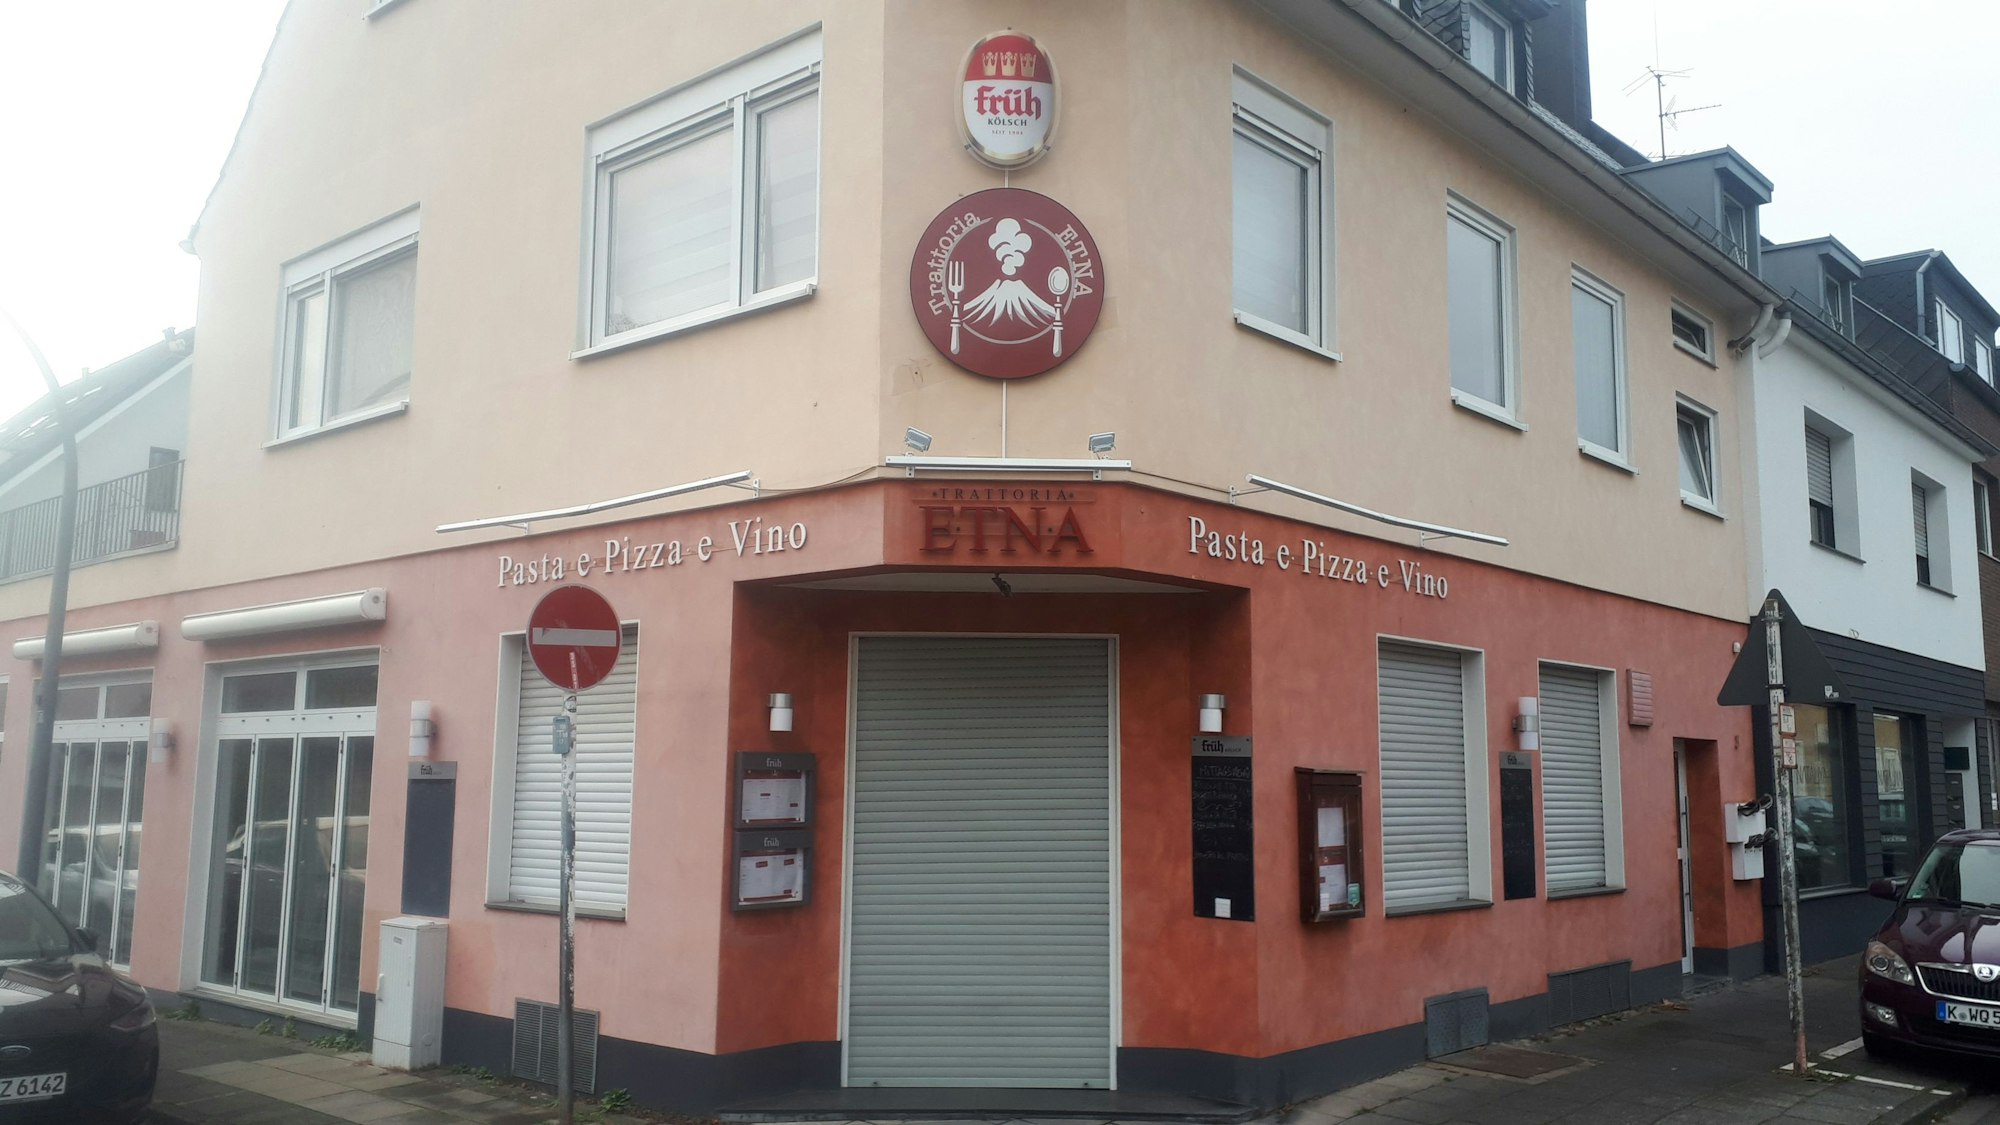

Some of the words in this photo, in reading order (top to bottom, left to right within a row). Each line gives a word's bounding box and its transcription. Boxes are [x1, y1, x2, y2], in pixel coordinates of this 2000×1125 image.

[974, 85, 1041, 120] früh
[988, 117, 1027, 126] KÖLSCH
[927, 212, 981, 316] Trattoria
[1055, 223, 1095, 299] ETNA
[939, 488, 1067, 501] TRATTORIA
[919, 506, 1094, 553] ETNA
[497, 552, 565, 587] Pasta
[577, 552, 591, 577] e
[604, 536, 683, 573] Pizza
[698, 535, 713, 562] e
[728, 516, 808, 558] Vino
[1188, 516, 1265, 565] Pasta
[1277, 543, 1290, 570] e
[1302, 539, 1368, 584] Pizza
[1378, 564, 1390, 588] e
[1399, 559, 1448, 599] Vino
[1201, 740, 1224, 753] früh
[766, 757, 782, 768] früh
[764, 837, 780, 847] früh
[1948, 1005, 1957, 1019] K
[1969, 1007, 1989, 1023] WQ
[0, 1080, 13, 1097] Z
[17, 1075, 64, 1096] 6142
